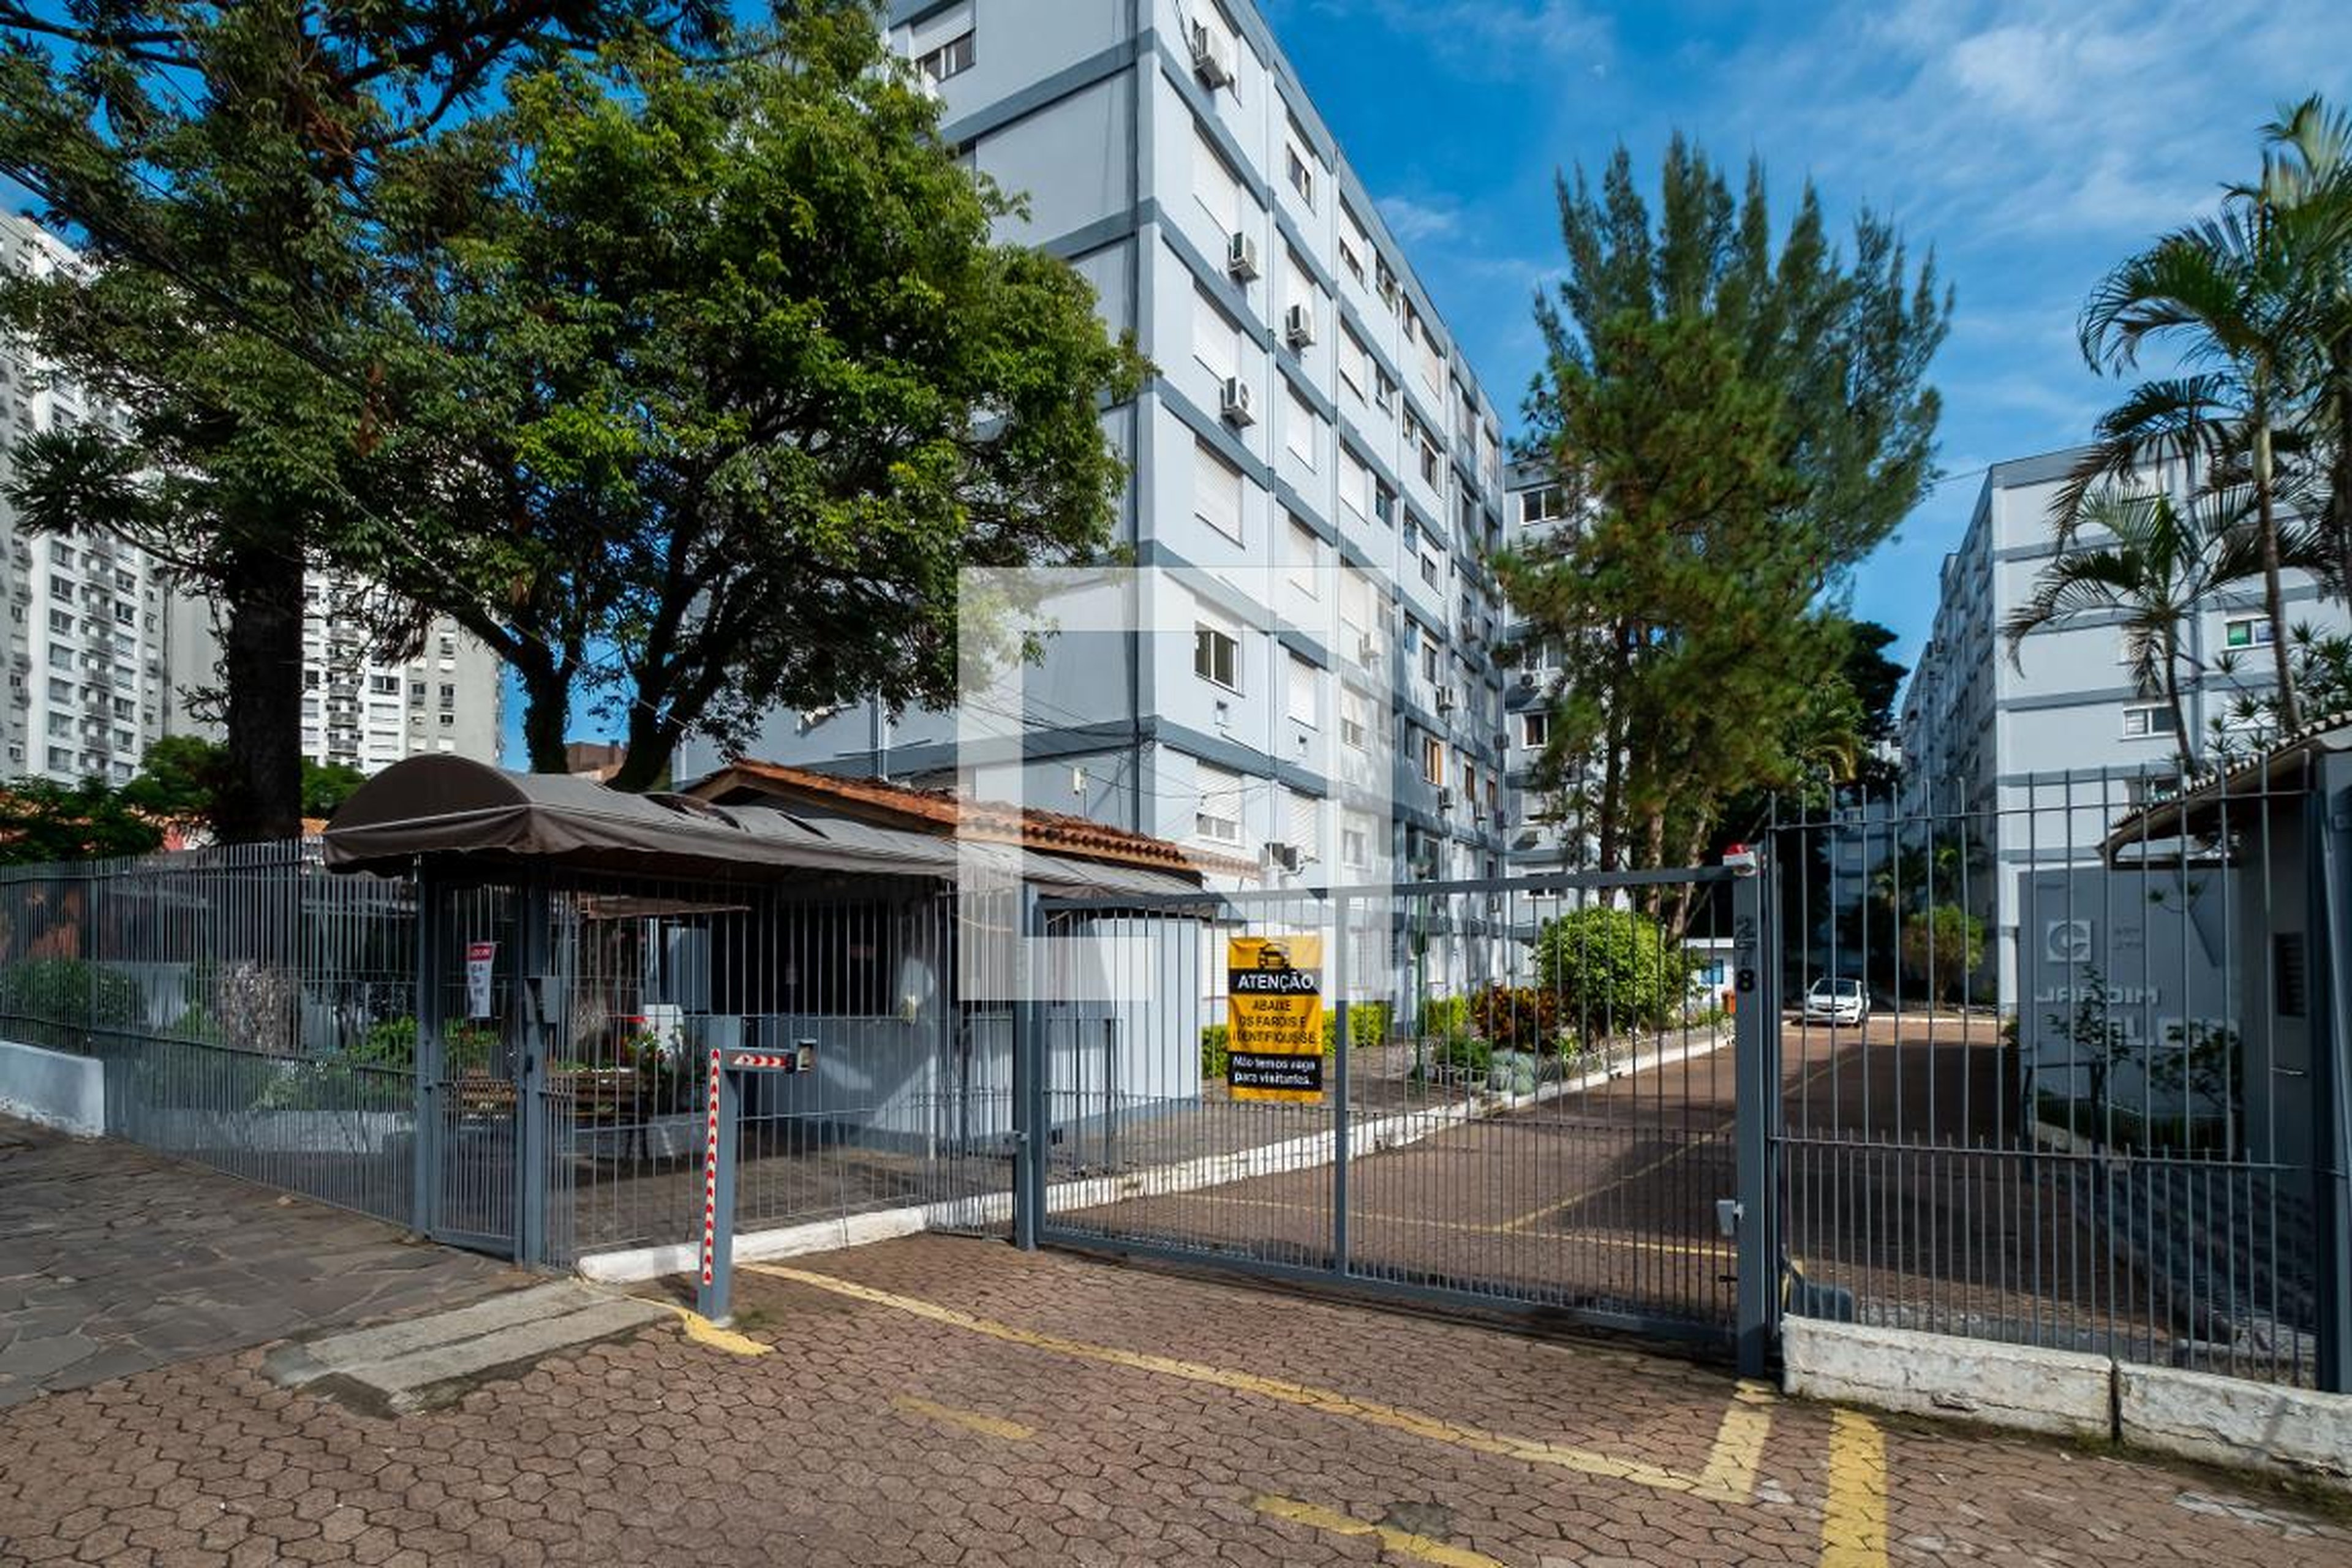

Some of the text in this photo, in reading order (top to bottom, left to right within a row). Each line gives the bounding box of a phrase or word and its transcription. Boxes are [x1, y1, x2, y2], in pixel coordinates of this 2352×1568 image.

[1238, 971, 1314, 992] ATENÇÃO
[1253, 1000, 1291, 1011] ABAIXE
[1239, 1016, 1254, 1027] OS
[1233, 1056, 1253, 1068] Não
[1256, 1058, 1287, 1069] temos
[1234, 1072, 1257, 1084] para
